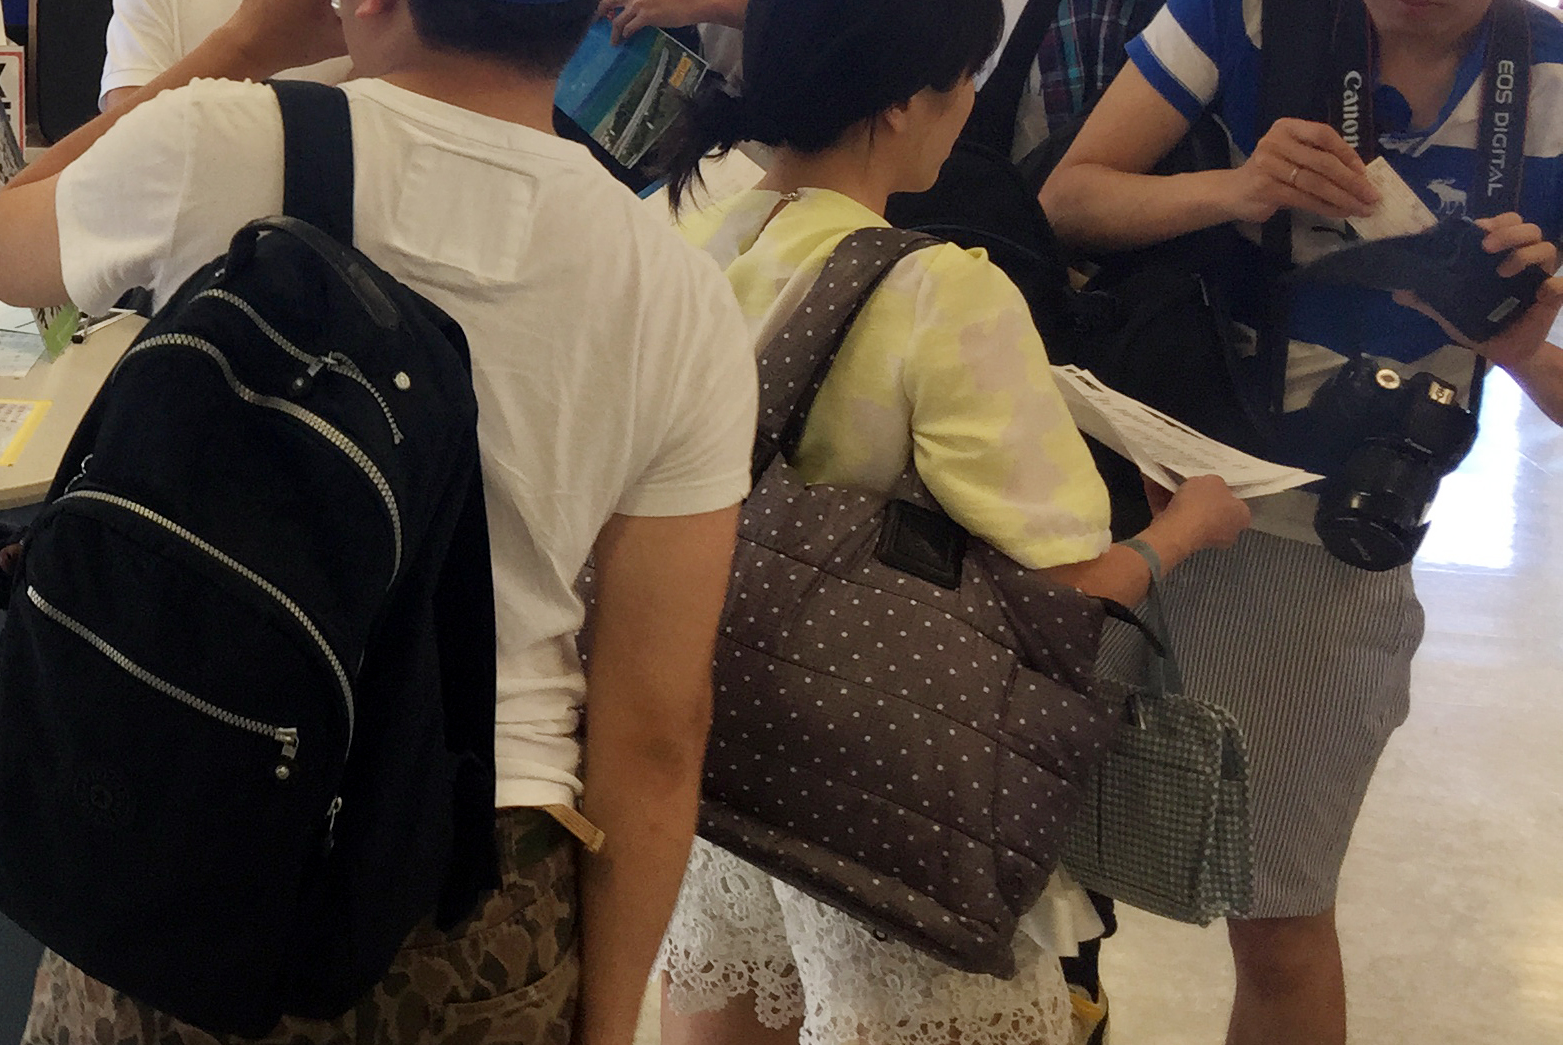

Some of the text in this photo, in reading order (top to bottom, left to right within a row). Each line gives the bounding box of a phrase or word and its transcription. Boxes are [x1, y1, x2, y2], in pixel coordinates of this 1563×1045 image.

[1342, 70, 1363, 149] Canon
[1488, 59, 1515, 197] EOS DIGITAL
